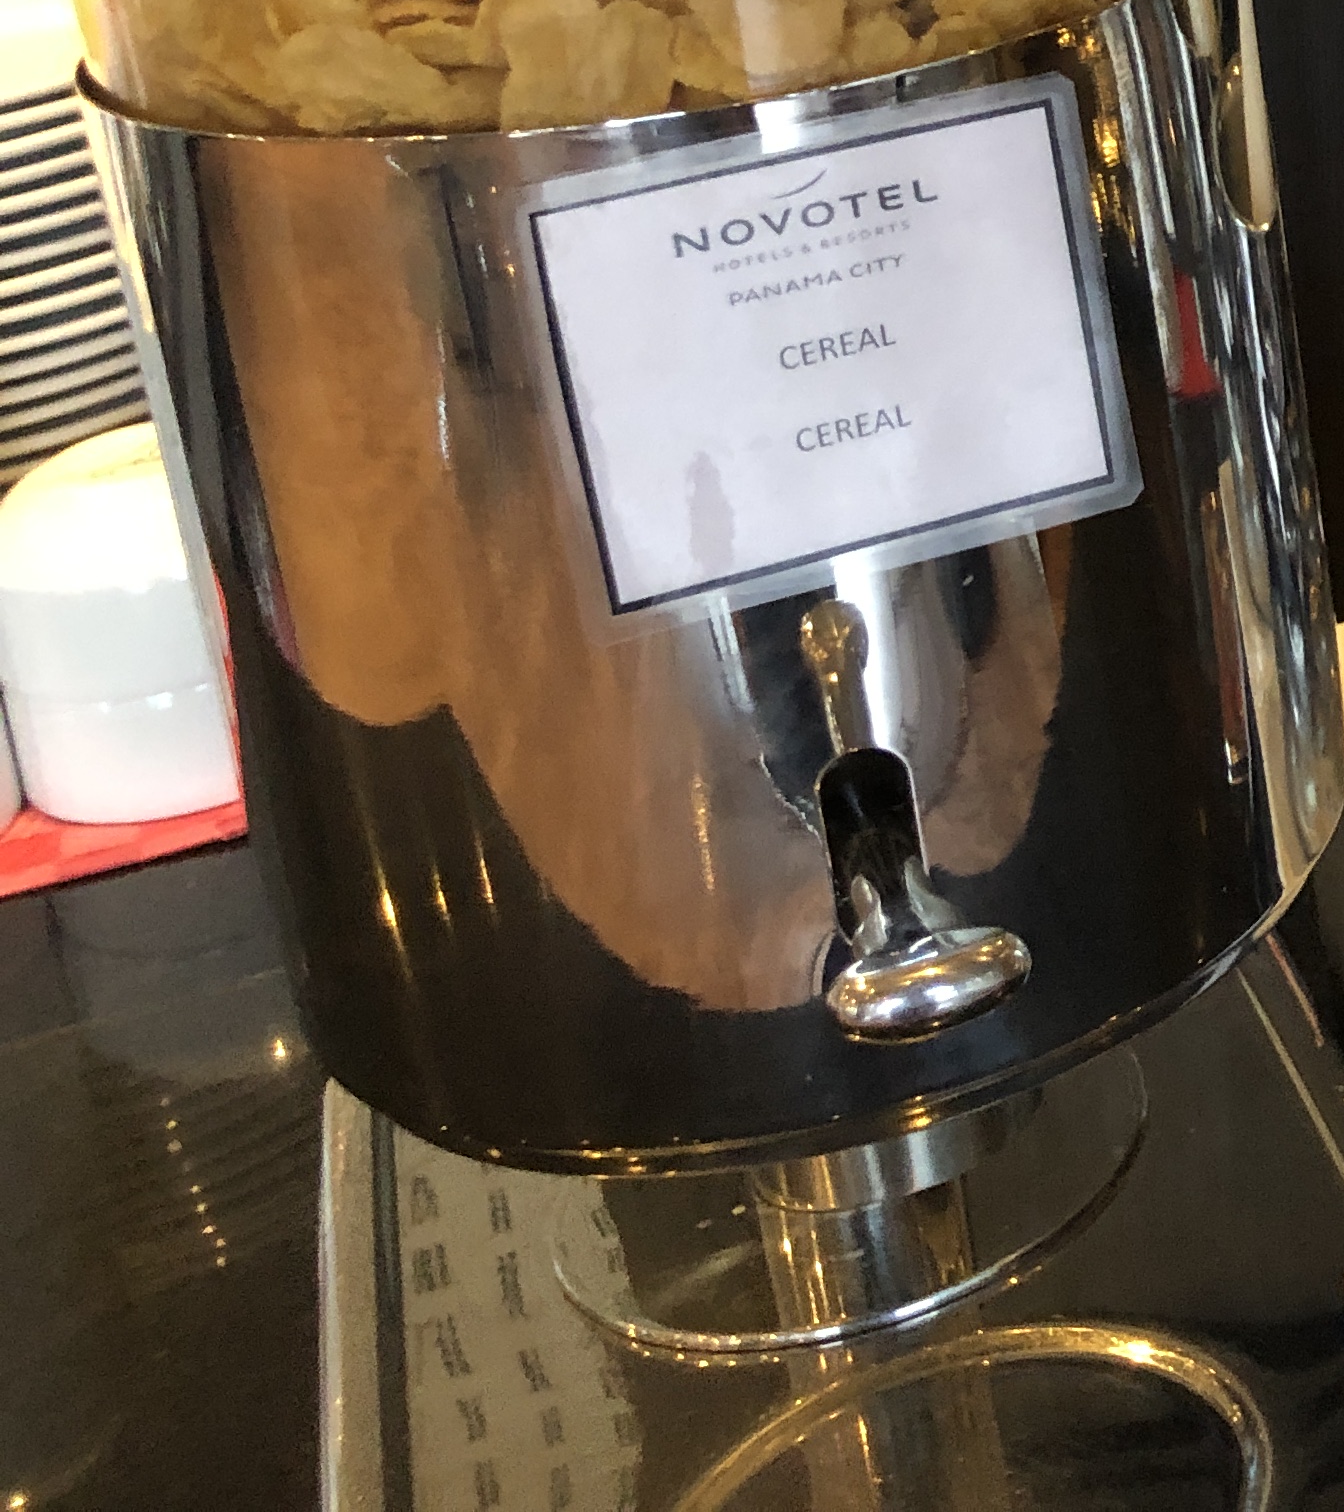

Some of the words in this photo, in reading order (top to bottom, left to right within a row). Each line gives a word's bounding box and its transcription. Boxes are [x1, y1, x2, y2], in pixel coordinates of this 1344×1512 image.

[673, 179, 938, 258] NOVOTEL
[714, 246, 793, 272] HOTELS
[800, 242, 810, 254] &
[819, 221, 911, 250] RESORTS
[728, 267, 842, 306] PANAMA
[849, 254, 906, 278] CITY
[779, 324, 896, 370] CEREAL
[795, 405, 912, 452] CEREAL
